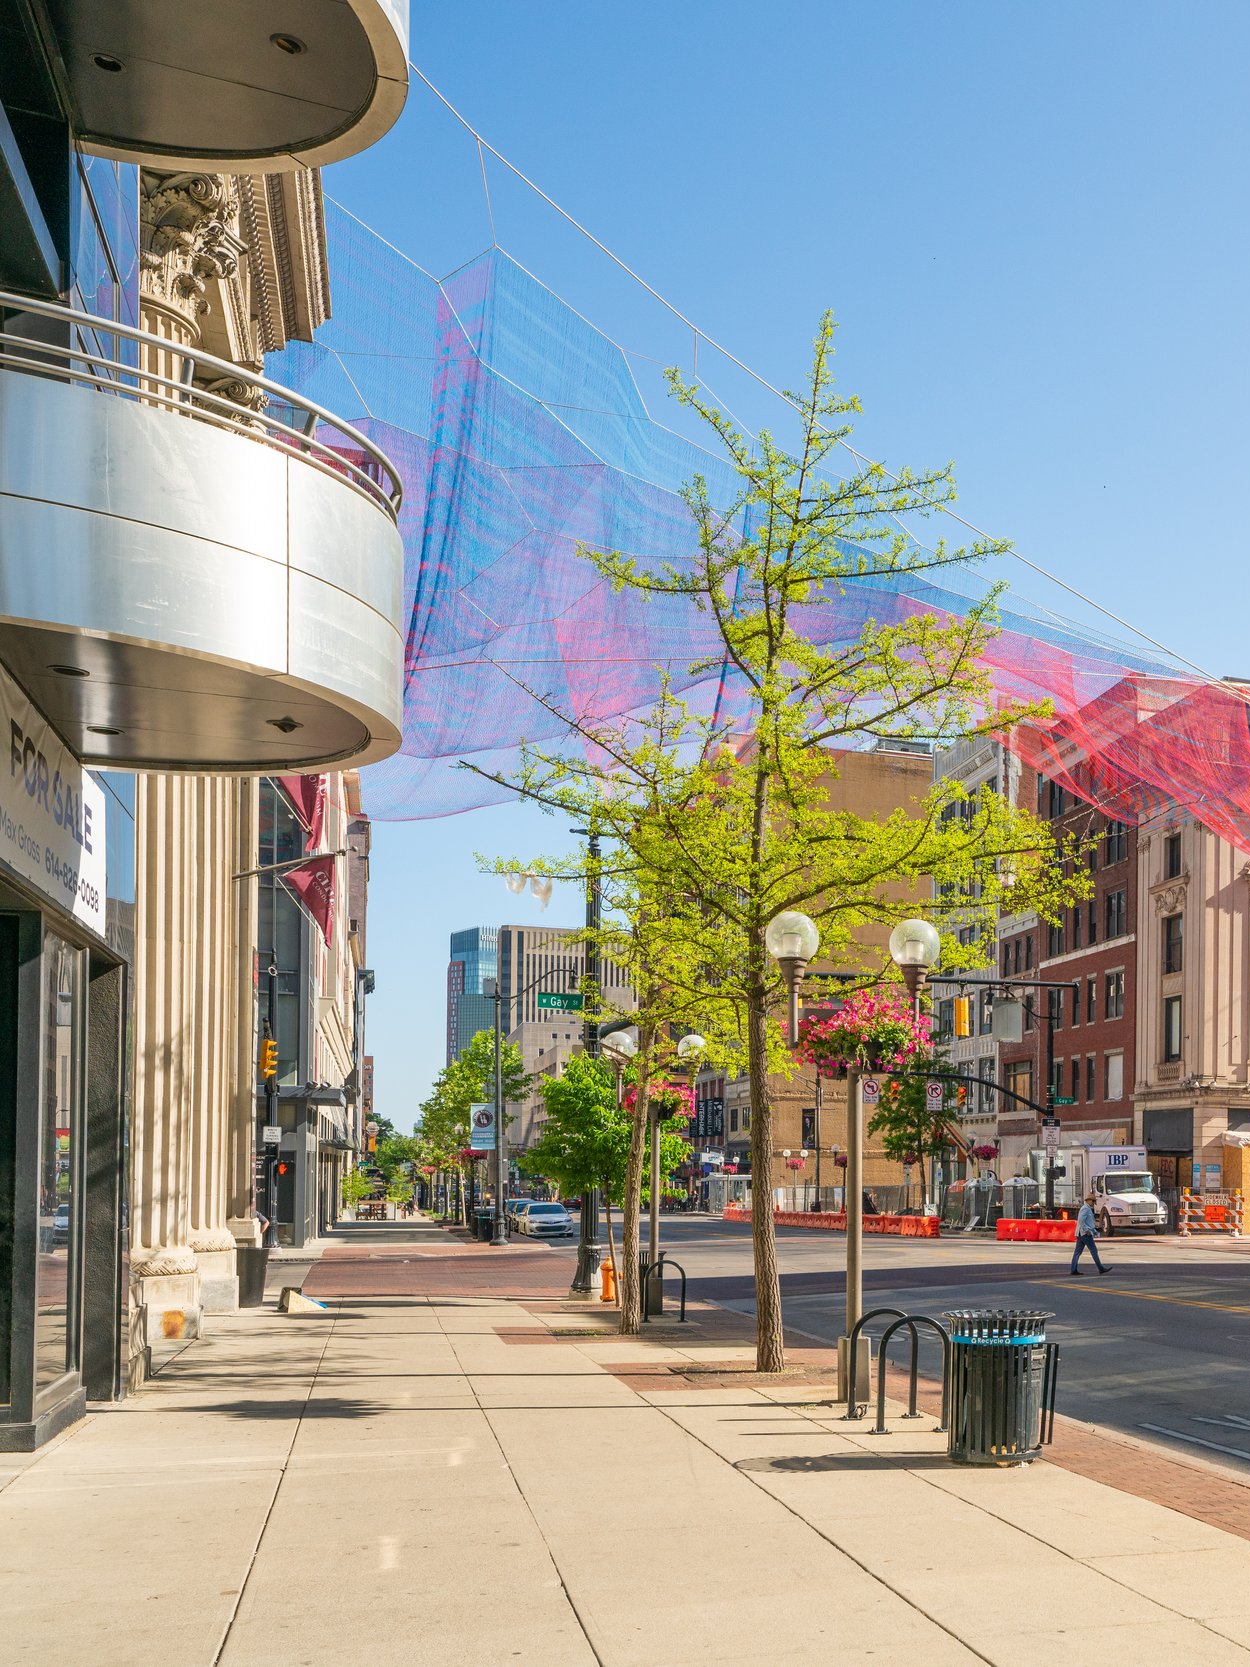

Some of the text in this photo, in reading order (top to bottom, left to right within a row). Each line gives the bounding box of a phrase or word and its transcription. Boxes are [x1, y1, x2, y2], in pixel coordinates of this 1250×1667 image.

[10, 717, 94, 856] FOR SALE
[18, 824, 41, 865] Gross
[44, 846, 100, 914] 614-826-0098
[550, 996, 568, 1008] Gay
[1107, 1154, 1128, 1166] IBP
